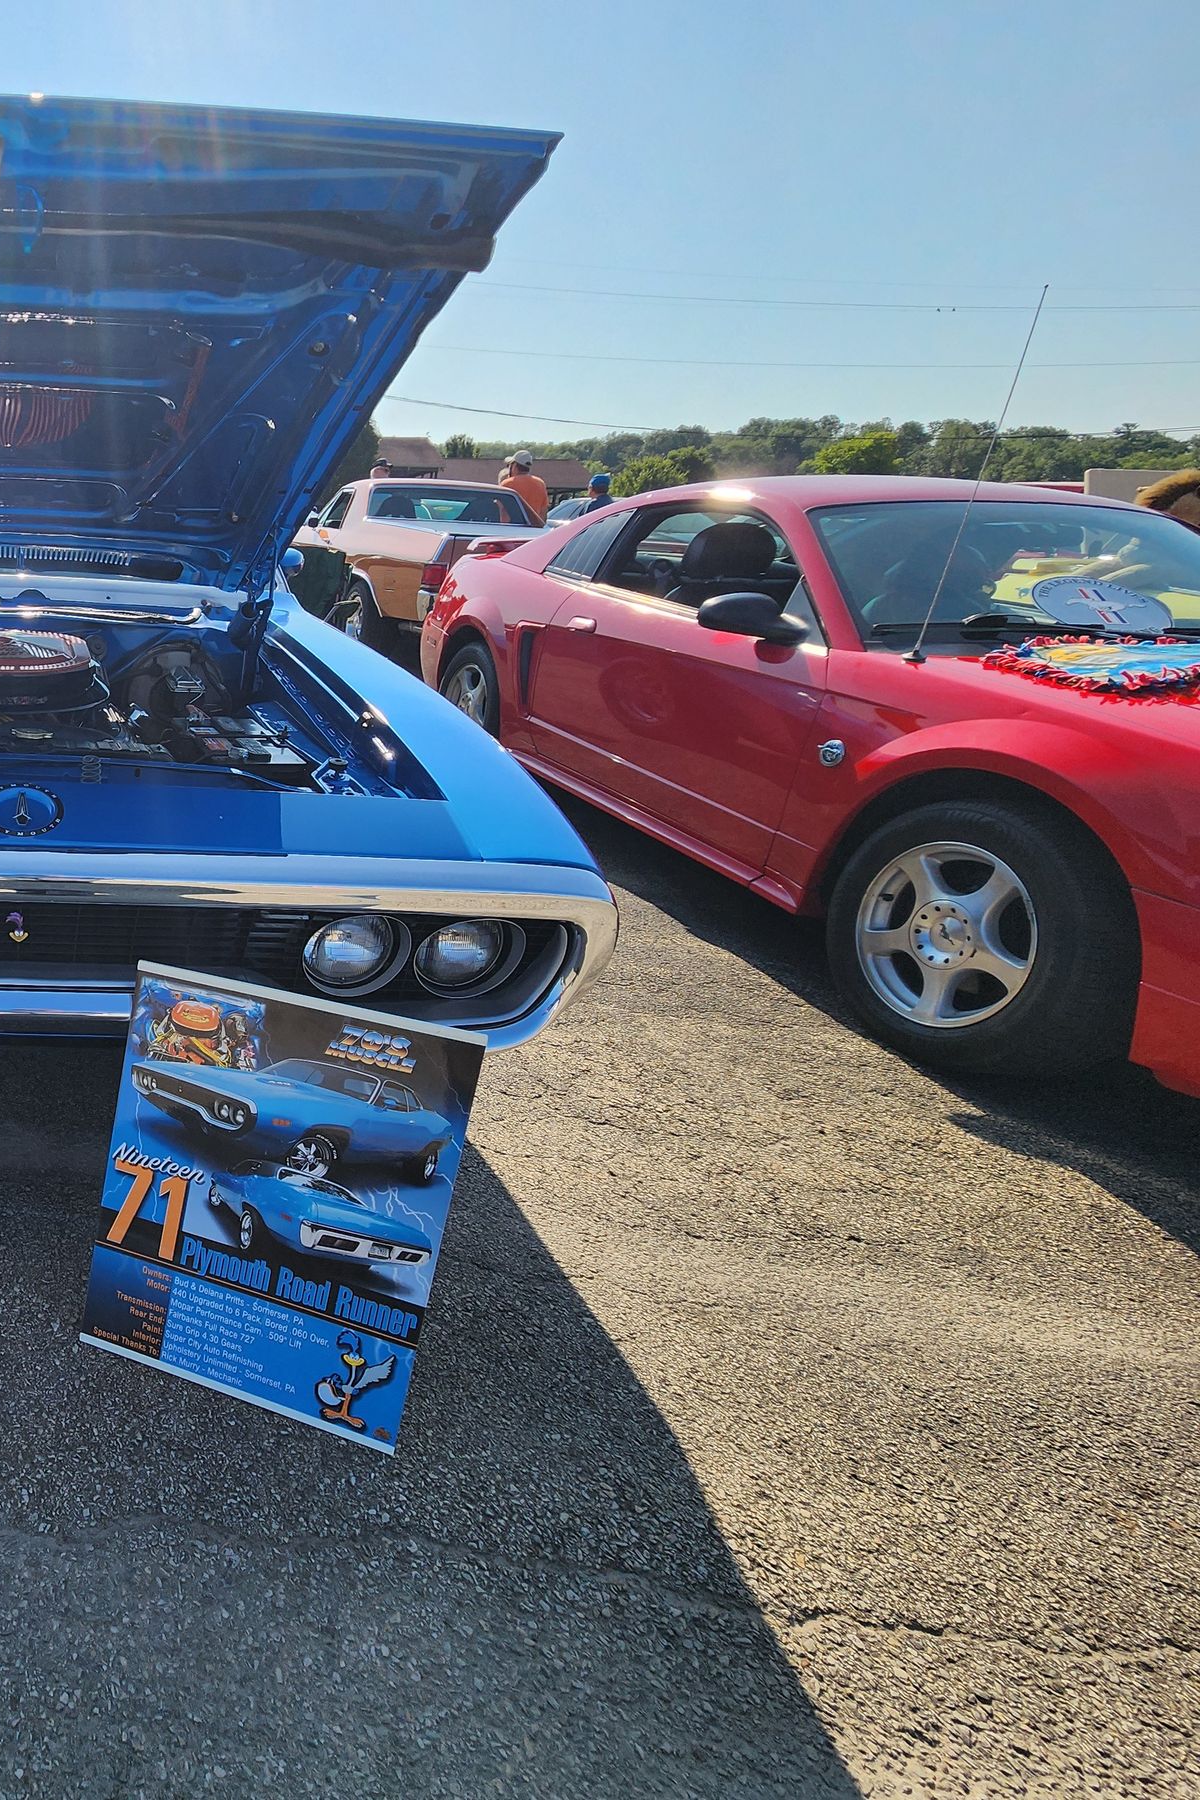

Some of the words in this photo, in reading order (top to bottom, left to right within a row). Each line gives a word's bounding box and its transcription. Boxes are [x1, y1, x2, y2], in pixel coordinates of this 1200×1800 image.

[1039, 585, 1053, 598] THE
[112, 1142, 205, 1183] Nineteen
[106, 1158, 188, 1261] 71
[143, 1266, 172, 1282] Owners:
[174, 1276, 189, 1289] Bud
[190, 1282, 196, 1290] &
[226, 1294, 245, 1307] Pritts
[293, 1315, 304, 1326] PA
[146, 1279, 170, 1292] Motor:
[172, 1287, 186, 1298] 440
[189, 1291, 224, 1312] Upgraded
[225, 1305, 233, 1314] to
[235, 1308, 240, 1316] 6
[265, 1318, 288, 1333] Bored
[289, 1329, 308, 1340] .060
[180, 1236, 272, 1292] Plymouth
[275, 1265, 332, 1312] Road
[334, 1284, 418, 1338] Runner
[117, 1290, 166, 1314] Transmission:
[169, 1309, 202, 1328] Fairbanks
[205, 1321, 217, 1332] Full
[220, 1326, 238, 1340] Race
[240, 1334, 255, 1344] 727
[130, 1306, 148, 1319] Rear
[149, 1313, 165, 1325] End:
[167, 1319, 183, 1332] Sure
[186, 1325, 200, 1338] Grip
[202, 1331, 219, 1344] 4.30
[221, 1338, 243, 1352] Gears
[171, 1298, 193, 1314] Mopar
[196, 1305, 242, 1329] Performance
[289, 1337, 301, 1350] Lift
[93, 1326, 119, 1342] Special
[121, 1335, 146, 1351] Thanks
[149, 1345, 159, 1356] To:
[161, 1351, 177, 1363] Rick
[179, 1356, 200, 1373] Murry
[207, 1367, 243, 1387] Mechanic
[132, 1329, 162, 1346] Interior:
[163, 1341, 201, 1361] Upholstery
[203, 1353, 238, 1373] Unlimited
[285, 1383, 296, 1395] PA
[142, 1321, 163, 1336] Paint:
[165, 1330, 186, 1345] Super
[187, 1338, 201, 1350] City
[203, 1344, 220, 1356] Auto
[222, 1349, 264, 1372] Refinishing
